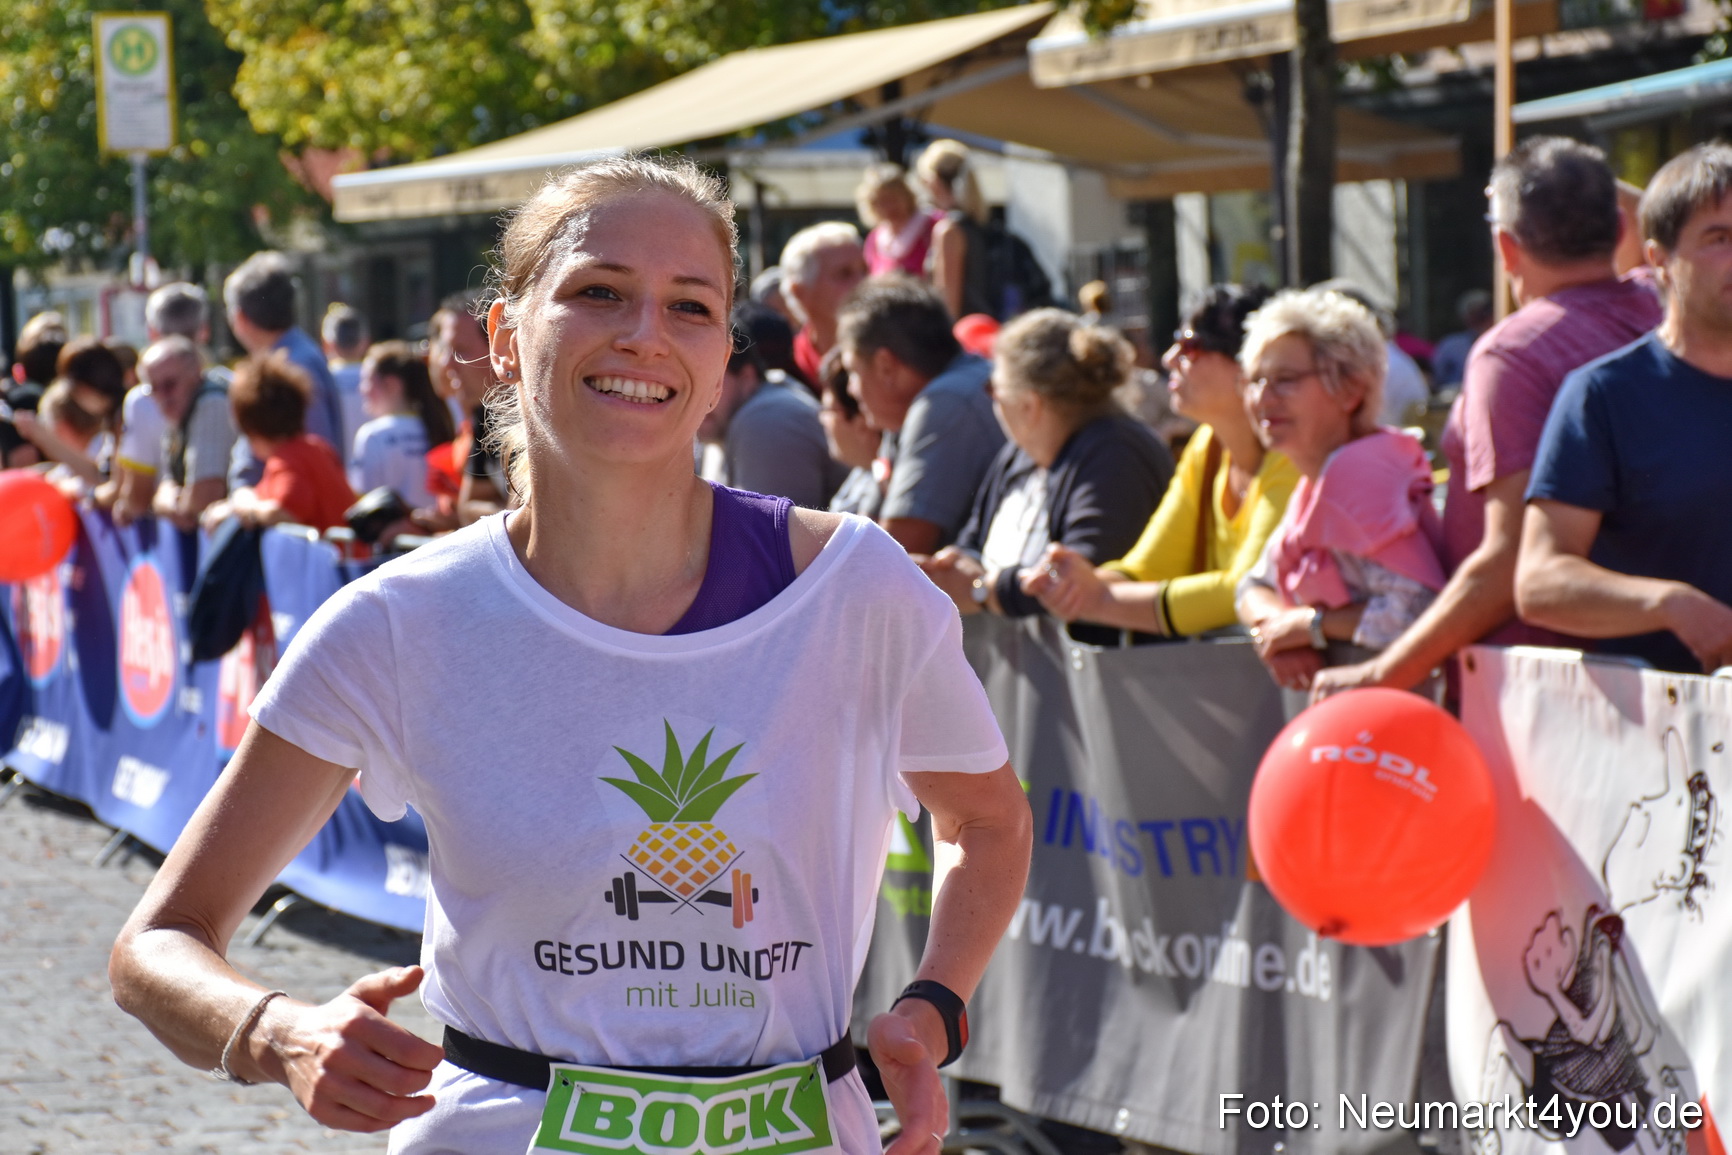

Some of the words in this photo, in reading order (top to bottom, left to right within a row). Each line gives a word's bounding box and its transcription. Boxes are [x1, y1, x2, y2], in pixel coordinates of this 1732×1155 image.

[534, 940, 685, 976] GESUND
[700, 941, 772, 981] UND
[770, 941, 813, 973] FIT
[626, 981, 679, 1008] mit
[689, 982, 755, 1008] Julia
[566, 1083, 806, 1150] BOCK
